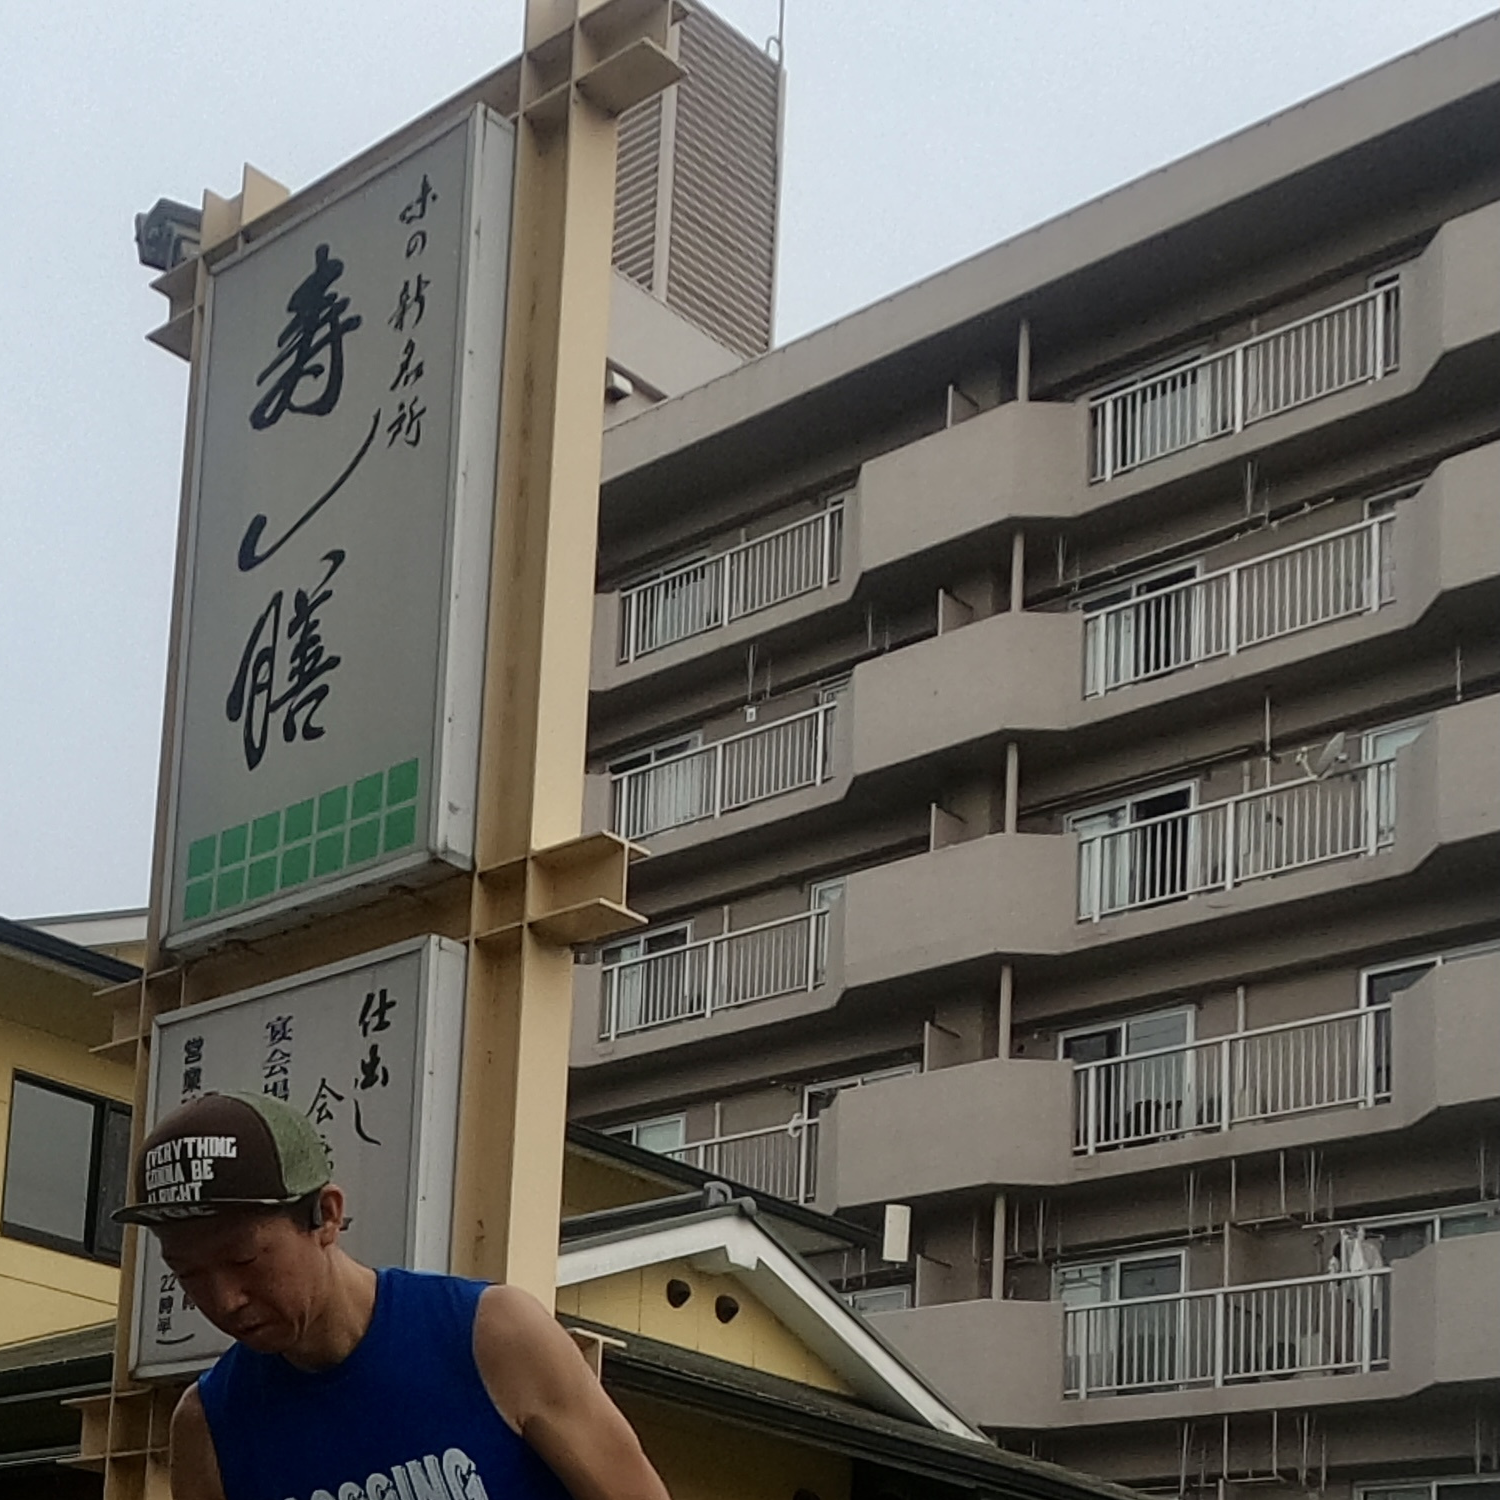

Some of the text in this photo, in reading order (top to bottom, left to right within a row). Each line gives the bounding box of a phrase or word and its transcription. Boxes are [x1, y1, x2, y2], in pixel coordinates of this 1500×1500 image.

[226, 244, 383, 771] 寿し膳
[353, 988, 398, 1146] 仕出し
[145, 1136, 237, 1171] EVERYTHING
[145, 1158, 215, 1191] GONNA BE
